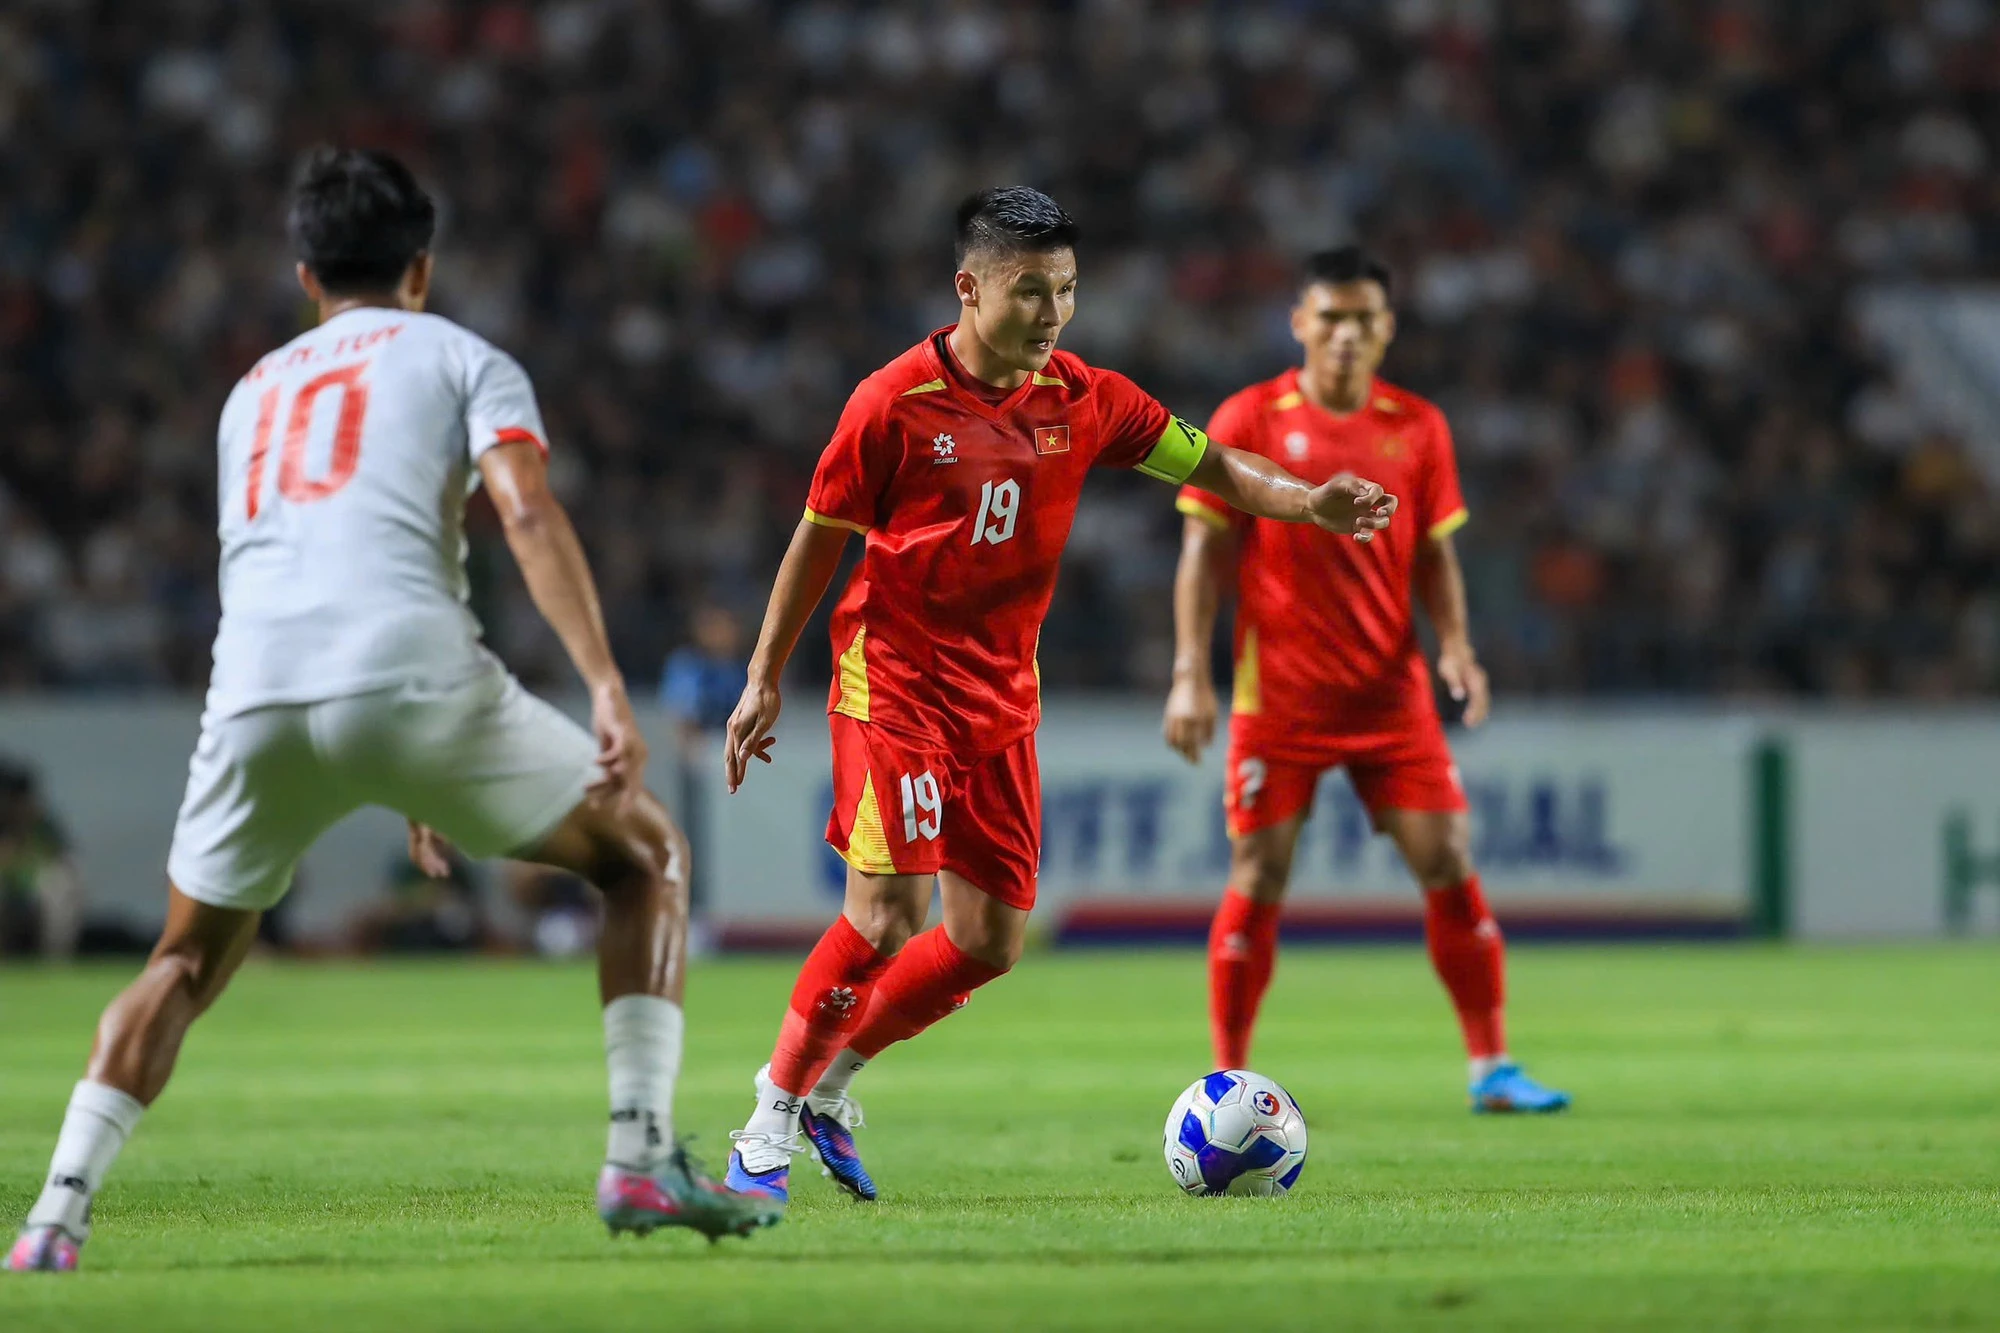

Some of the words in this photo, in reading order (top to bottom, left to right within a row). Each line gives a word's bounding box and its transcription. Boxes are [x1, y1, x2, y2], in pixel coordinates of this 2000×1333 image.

[245, 358, 371, 522] 10
[970, 478, 1021, 546] 19
[900, 769, 943, 844] 19
